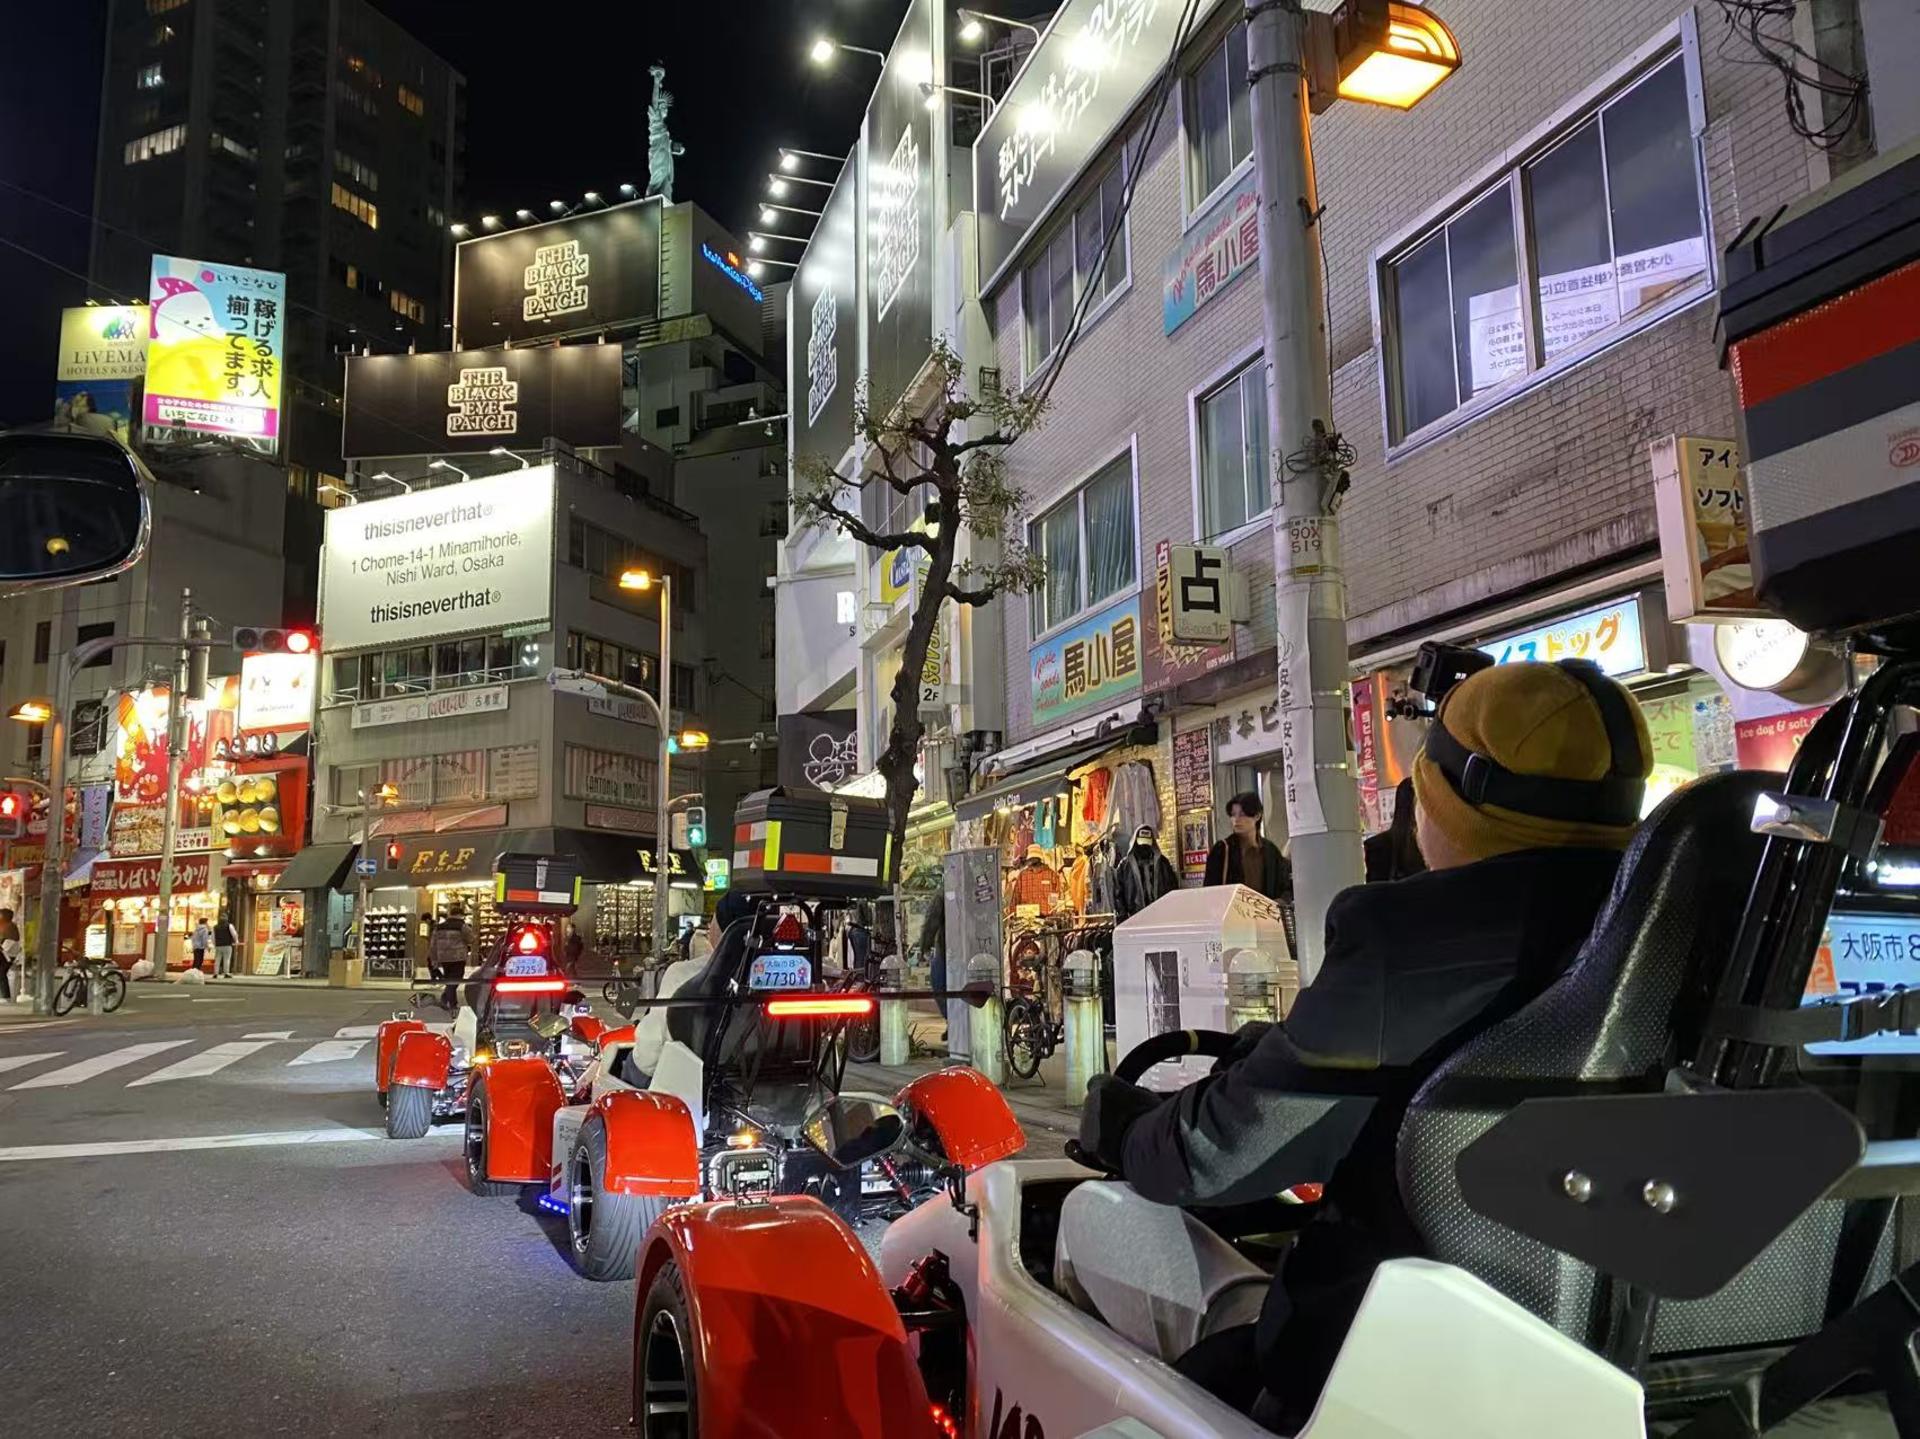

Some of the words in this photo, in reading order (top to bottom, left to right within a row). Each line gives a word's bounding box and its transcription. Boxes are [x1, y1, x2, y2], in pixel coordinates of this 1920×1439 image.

[537, 244, 576, 267] THE
[1196, 214, 1260, 301] 馬小屋
[528, 257, 586, 286] BLACK
[540, 277, 573, 297] EYE
[526, 289, 585, 317] PATCH
[250, 297, 277, 399] 稼げる求人
[463, 371, 502, 386] THE
[452, 385, 513, 401] BLACK
[465, 400, 500, 416] EYE
[450, 413, 514, 431] PATCH
[352, 560, 357, 575] 1
[360, 545, 435, 574] Chome-14-1
[439, 530, 522, 559] Minamihorie,
[386, 568, 418, 587] Nishi
[421, 560, 458, 580] Ward,
[462, 553, 505, 573] Osaka
[1180, 550, 1222, 614] 占
[1064, 617, 1137, 699] 馬小屋
[922, 688, 940, 702] 2F
[1756, 721, 1775, 738] dog
[1776, 719, 1787, 732] &
[1840, 932, 1904, 962] 大阪市
[765, 971, 796, 986] 7730
